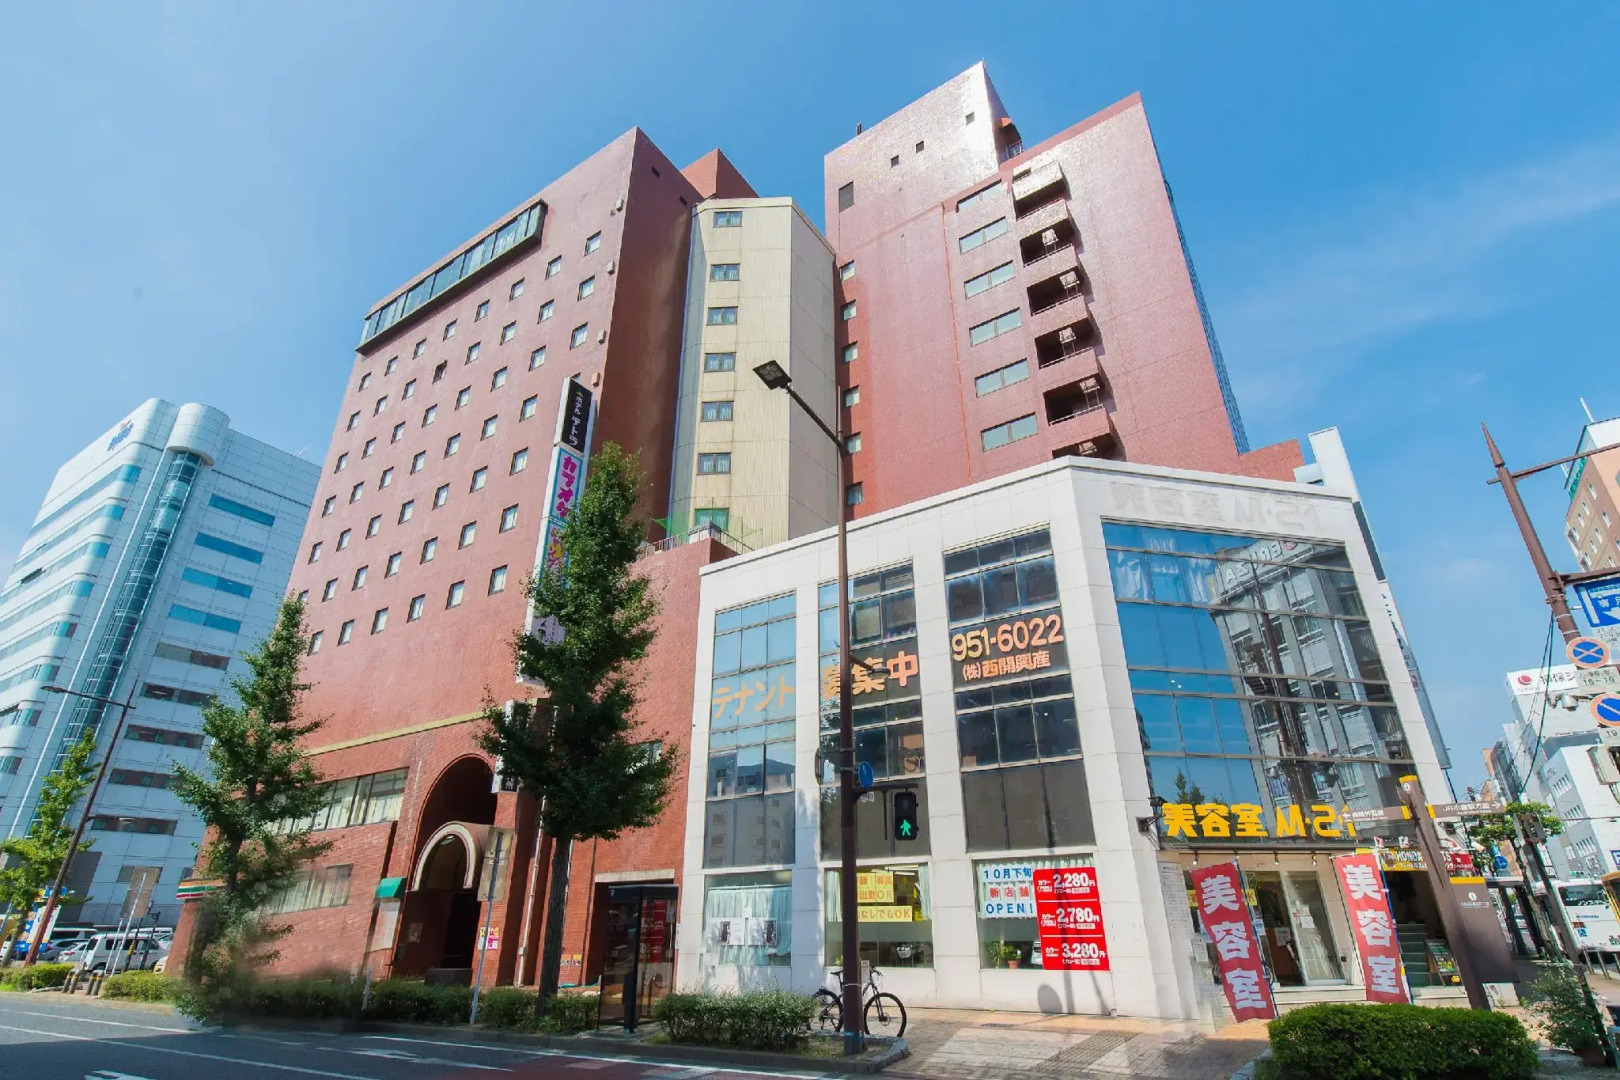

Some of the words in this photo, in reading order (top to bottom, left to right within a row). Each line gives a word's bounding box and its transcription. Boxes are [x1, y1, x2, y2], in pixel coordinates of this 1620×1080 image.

[574, 396, 584, 415] ホテル
[568, 415, 582, 446] テトラ
[556, 455, 578, 518] カラオケ
[951, 614, 1064, 662] 951-6022
[820, 650, 919, 701] 募集中
[711, 674, 795, 720] テナント
[1161, 802, 1269, 838] 美容室
[984, 867, 1032, 879] 10月下旬
[1053, 873, 1095, 888] 2,280円
[989, 886, 1029, 898] 新店舗
[858, 909, 911, 919] なしでもOK
[985, 902, 1034, 914] OPEN!
[1056, 907, 1099, 923] 2,780円
[1201, 875, 1268, 1010] 美容室
[1343, 864, 1400, 995] 美容室
